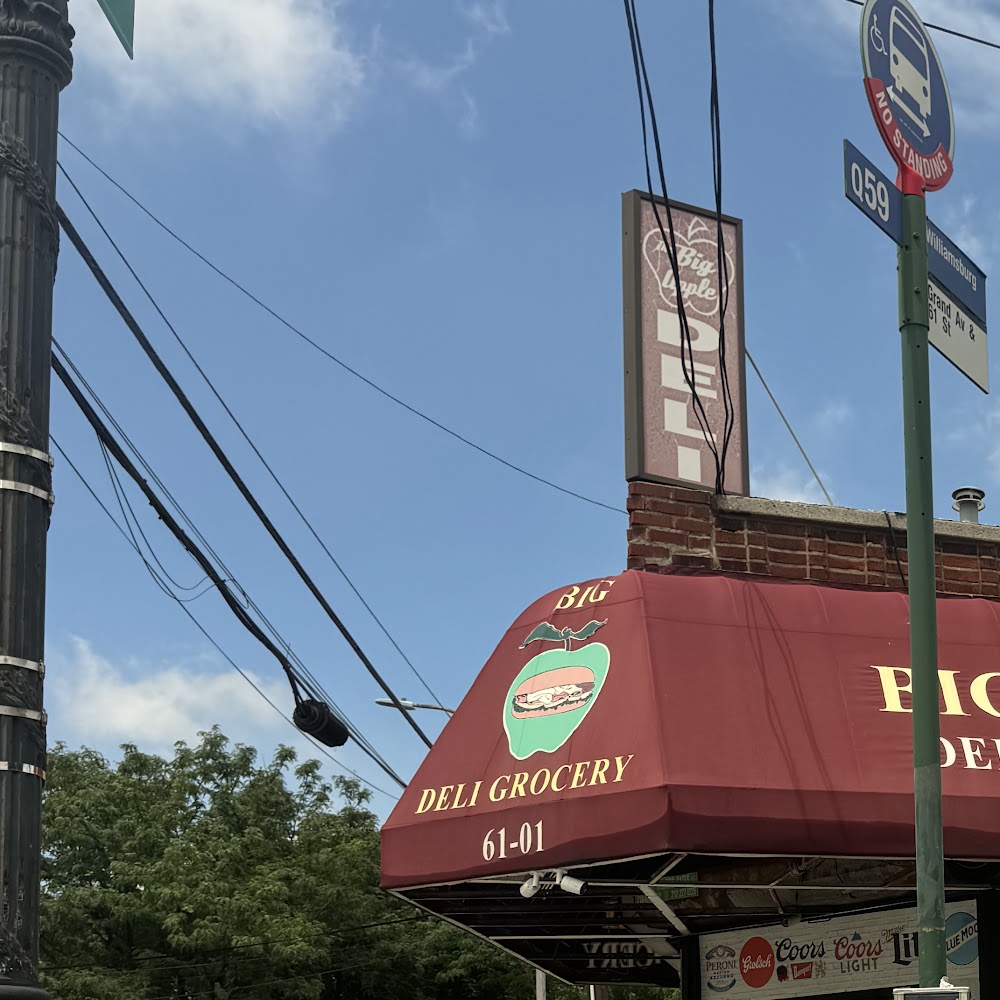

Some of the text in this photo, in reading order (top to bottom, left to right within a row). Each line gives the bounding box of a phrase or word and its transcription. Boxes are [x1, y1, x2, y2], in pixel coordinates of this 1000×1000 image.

[875, 91, 948, 180] NO STANDING
[851, 162, 890, 222] Q59
[676, 244, 716, 277] Big
[926, 226, 977, 291] Williamsburg
[928, 284, 976, 342] Grand Av &
[928, 303, 952, 338] 61 St
[657, 309, 720, 483] DELI
[554, 579, 616, 612] BIG
[414, 754, 635, 815] DELI GROCERY
[482, 819, 545, 862] 61-01
[775, 938, 826, 962] Coors
[833, 936, 884, 961] Coors
[892, 932, 918, 966] Lit
[945, 936, 960, 952] LUE
[706, 960, 736, 972] PERONI
[742, 954, 772, 974] Grolsch
[840, 958, 879, 974] LIGHT
